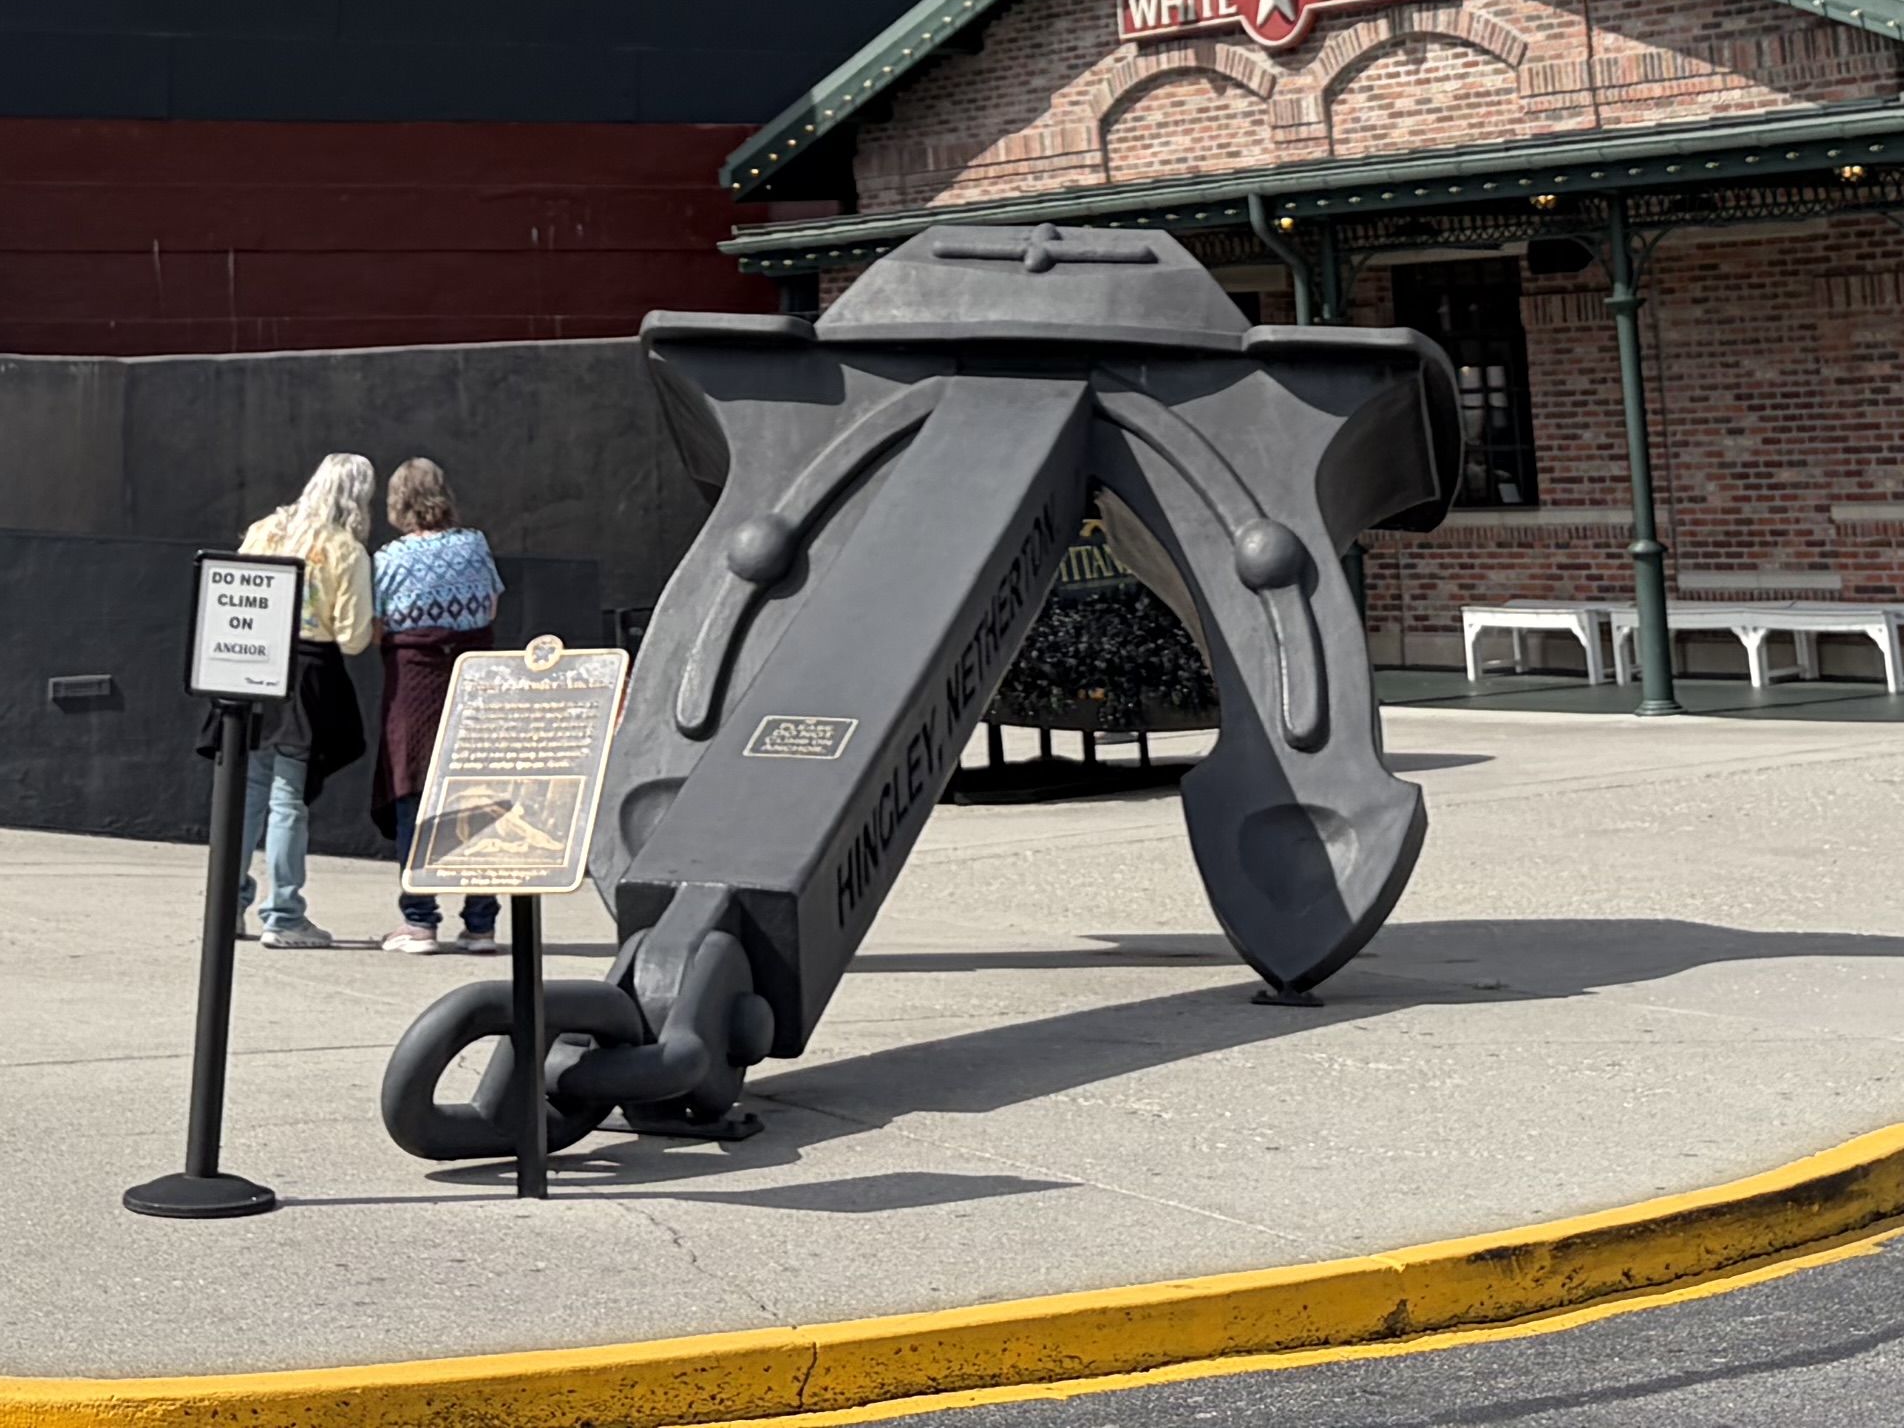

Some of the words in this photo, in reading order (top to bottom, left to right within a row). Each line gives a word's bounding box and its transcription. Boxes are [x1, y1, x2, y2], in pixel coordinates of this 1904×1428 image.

[211, 571, 235, 585] DO
[240, 573, 275, 588] NOT
[217, 593, 269, 609] CLIMB
[229, 616, 253, 630] ON
[213, 641, 266, 656] ANCHOR
